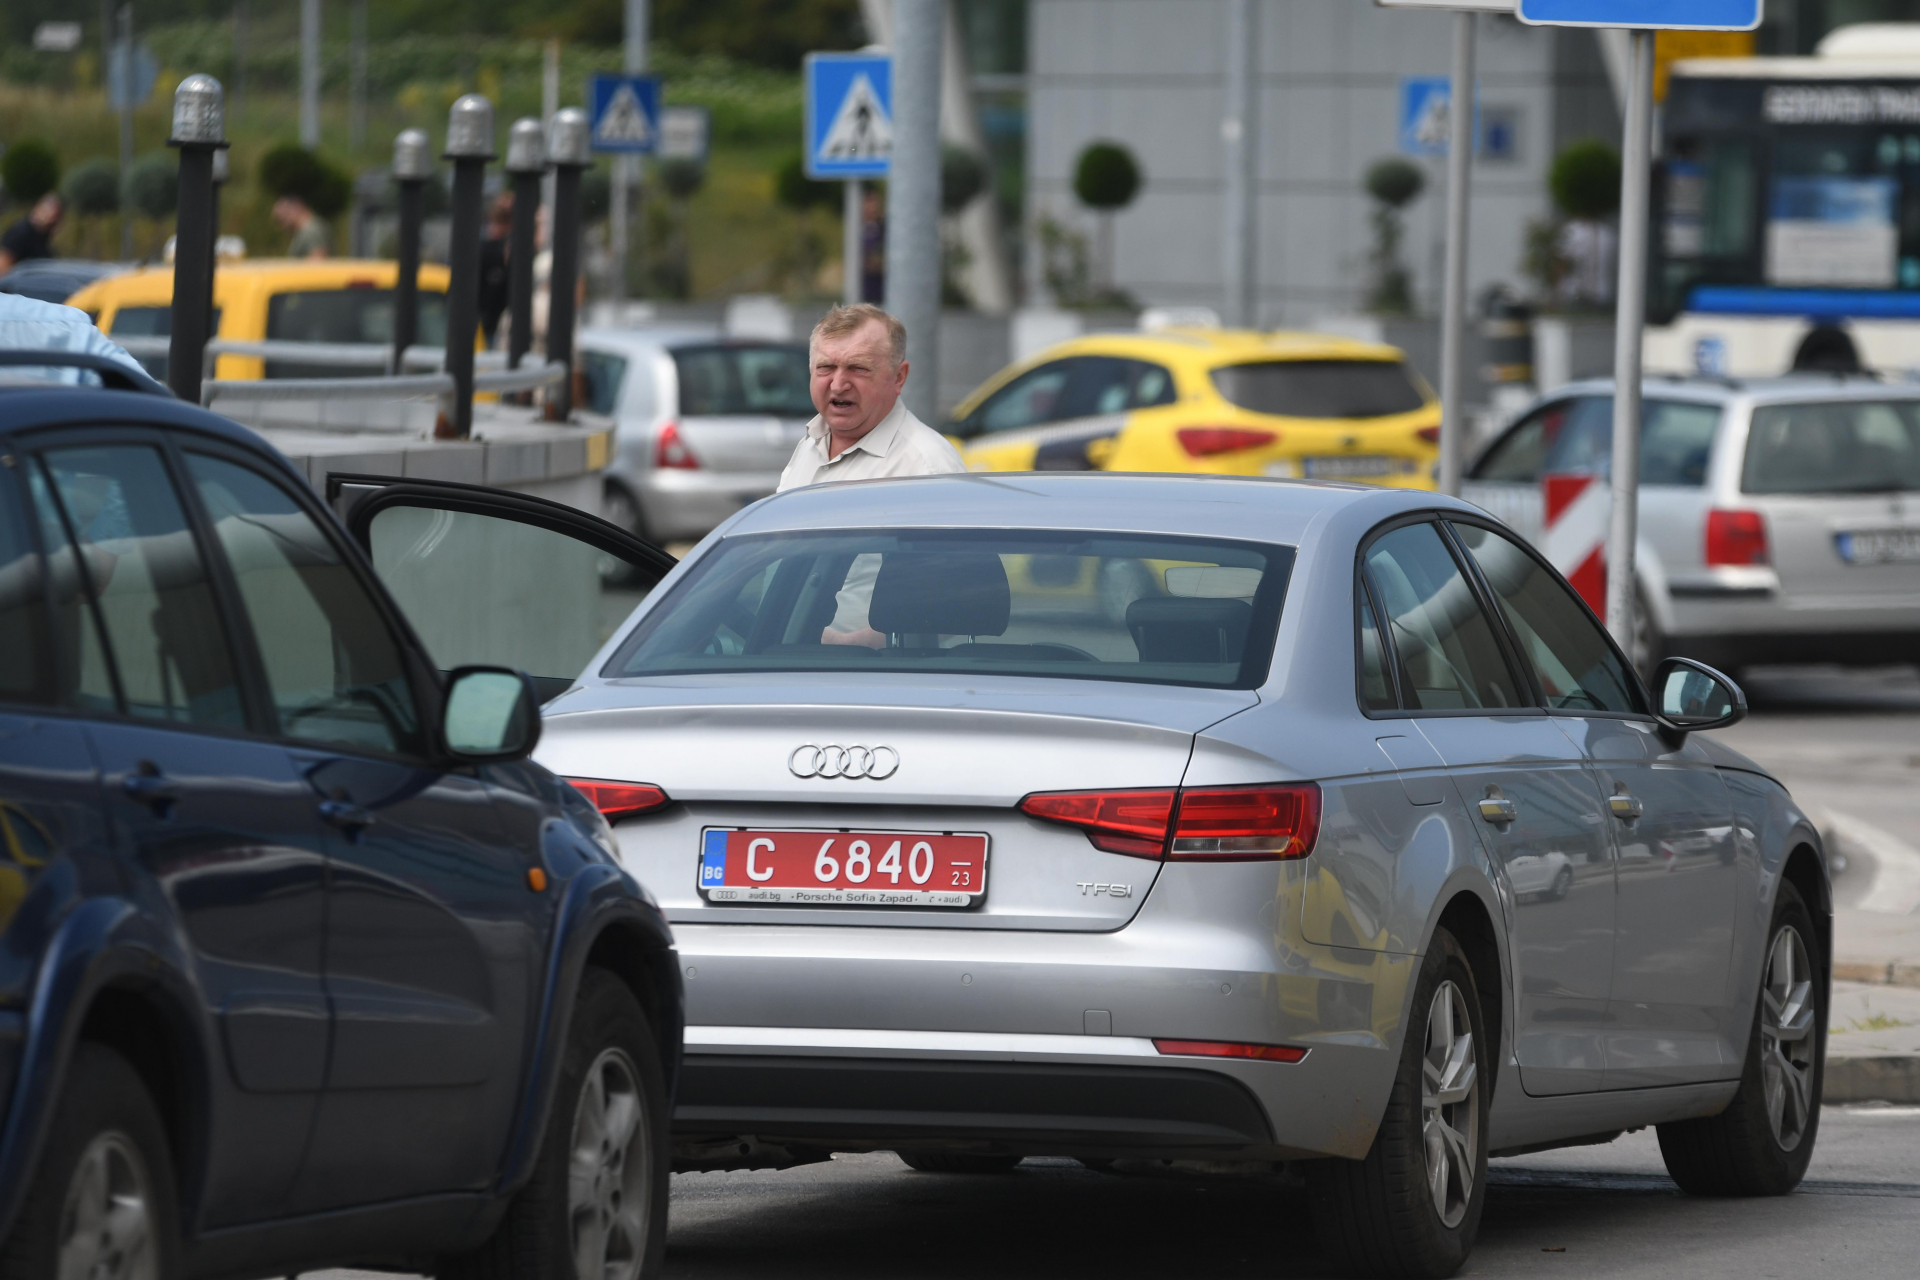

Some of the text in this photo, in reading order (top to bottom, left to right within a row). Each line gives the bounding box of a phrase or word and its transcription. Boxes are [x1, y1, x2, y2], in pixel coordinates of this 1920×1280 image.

[746, 837, 935, 885] C 6840
[704, 866, 723, 880] BG
[951, 871, 971, 886] 23
[748, 890, 913, 904] audi.bg Porsche Sofia Zapad
[1076, 882, 1132, 898] TFSI
[943, 894, 963, 904] audi
